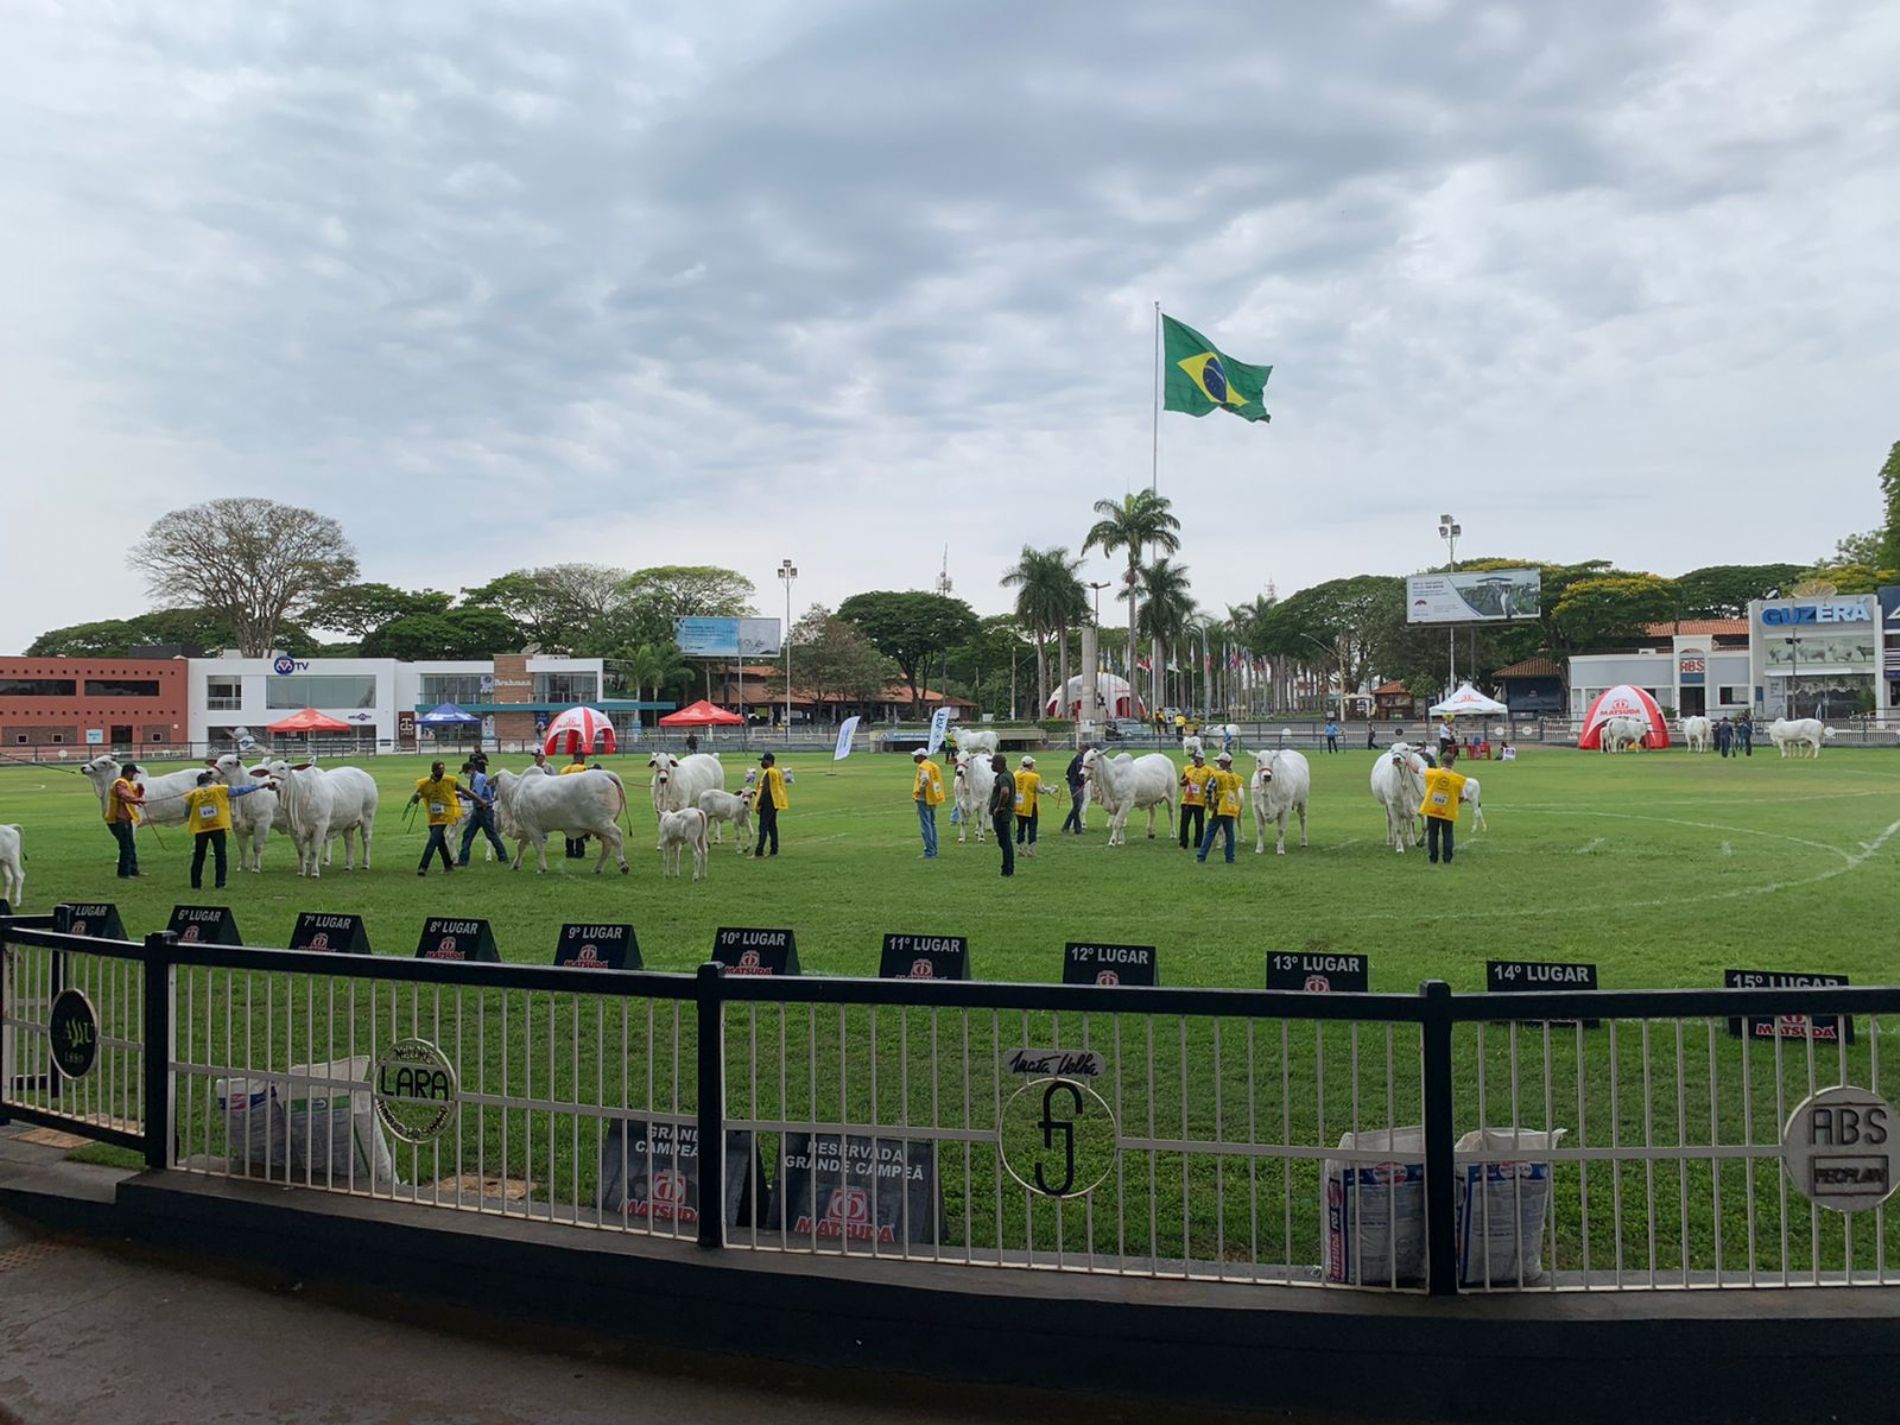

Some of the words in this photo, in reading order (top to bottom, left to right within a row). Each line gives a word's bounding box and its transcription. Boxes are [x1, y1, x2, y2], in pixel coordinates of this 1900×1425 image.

[75, 905, 107, 917] LUGAR
[178, 909, 188, 921] 6º
[188, 910, 222, 922] LUGAR
[304, 915, 315, 926] 7º
[315, 915, 351, 929] LUGAR
[430, 921, 442, 933] 8º
[442, 921, 479, 934] LUGAR
[568, 927, 581, 939] 9º
[582, 927, 623, 939] LUGAR
[720, 932, 741, 945] 10º
[742, 932, 785, 946] LUGAR
[888, 937, 911, 950] 11º
[913, 938, 960, 952] LUGAR
[1071, 947, 1094, 961] 12º
[1098, 947, 1149, 964] LUGAR
[1272, 955, 1299, 970] 13º
[1303, 956, 1360, 973] LUGAR
[1493, 964, 1522, 981] 14º
[1526, 965, 1589, 982] LUGAR
[380, 1065, 449, 1103] LARA
[1811, 1107, 1888, 1146] ABS
